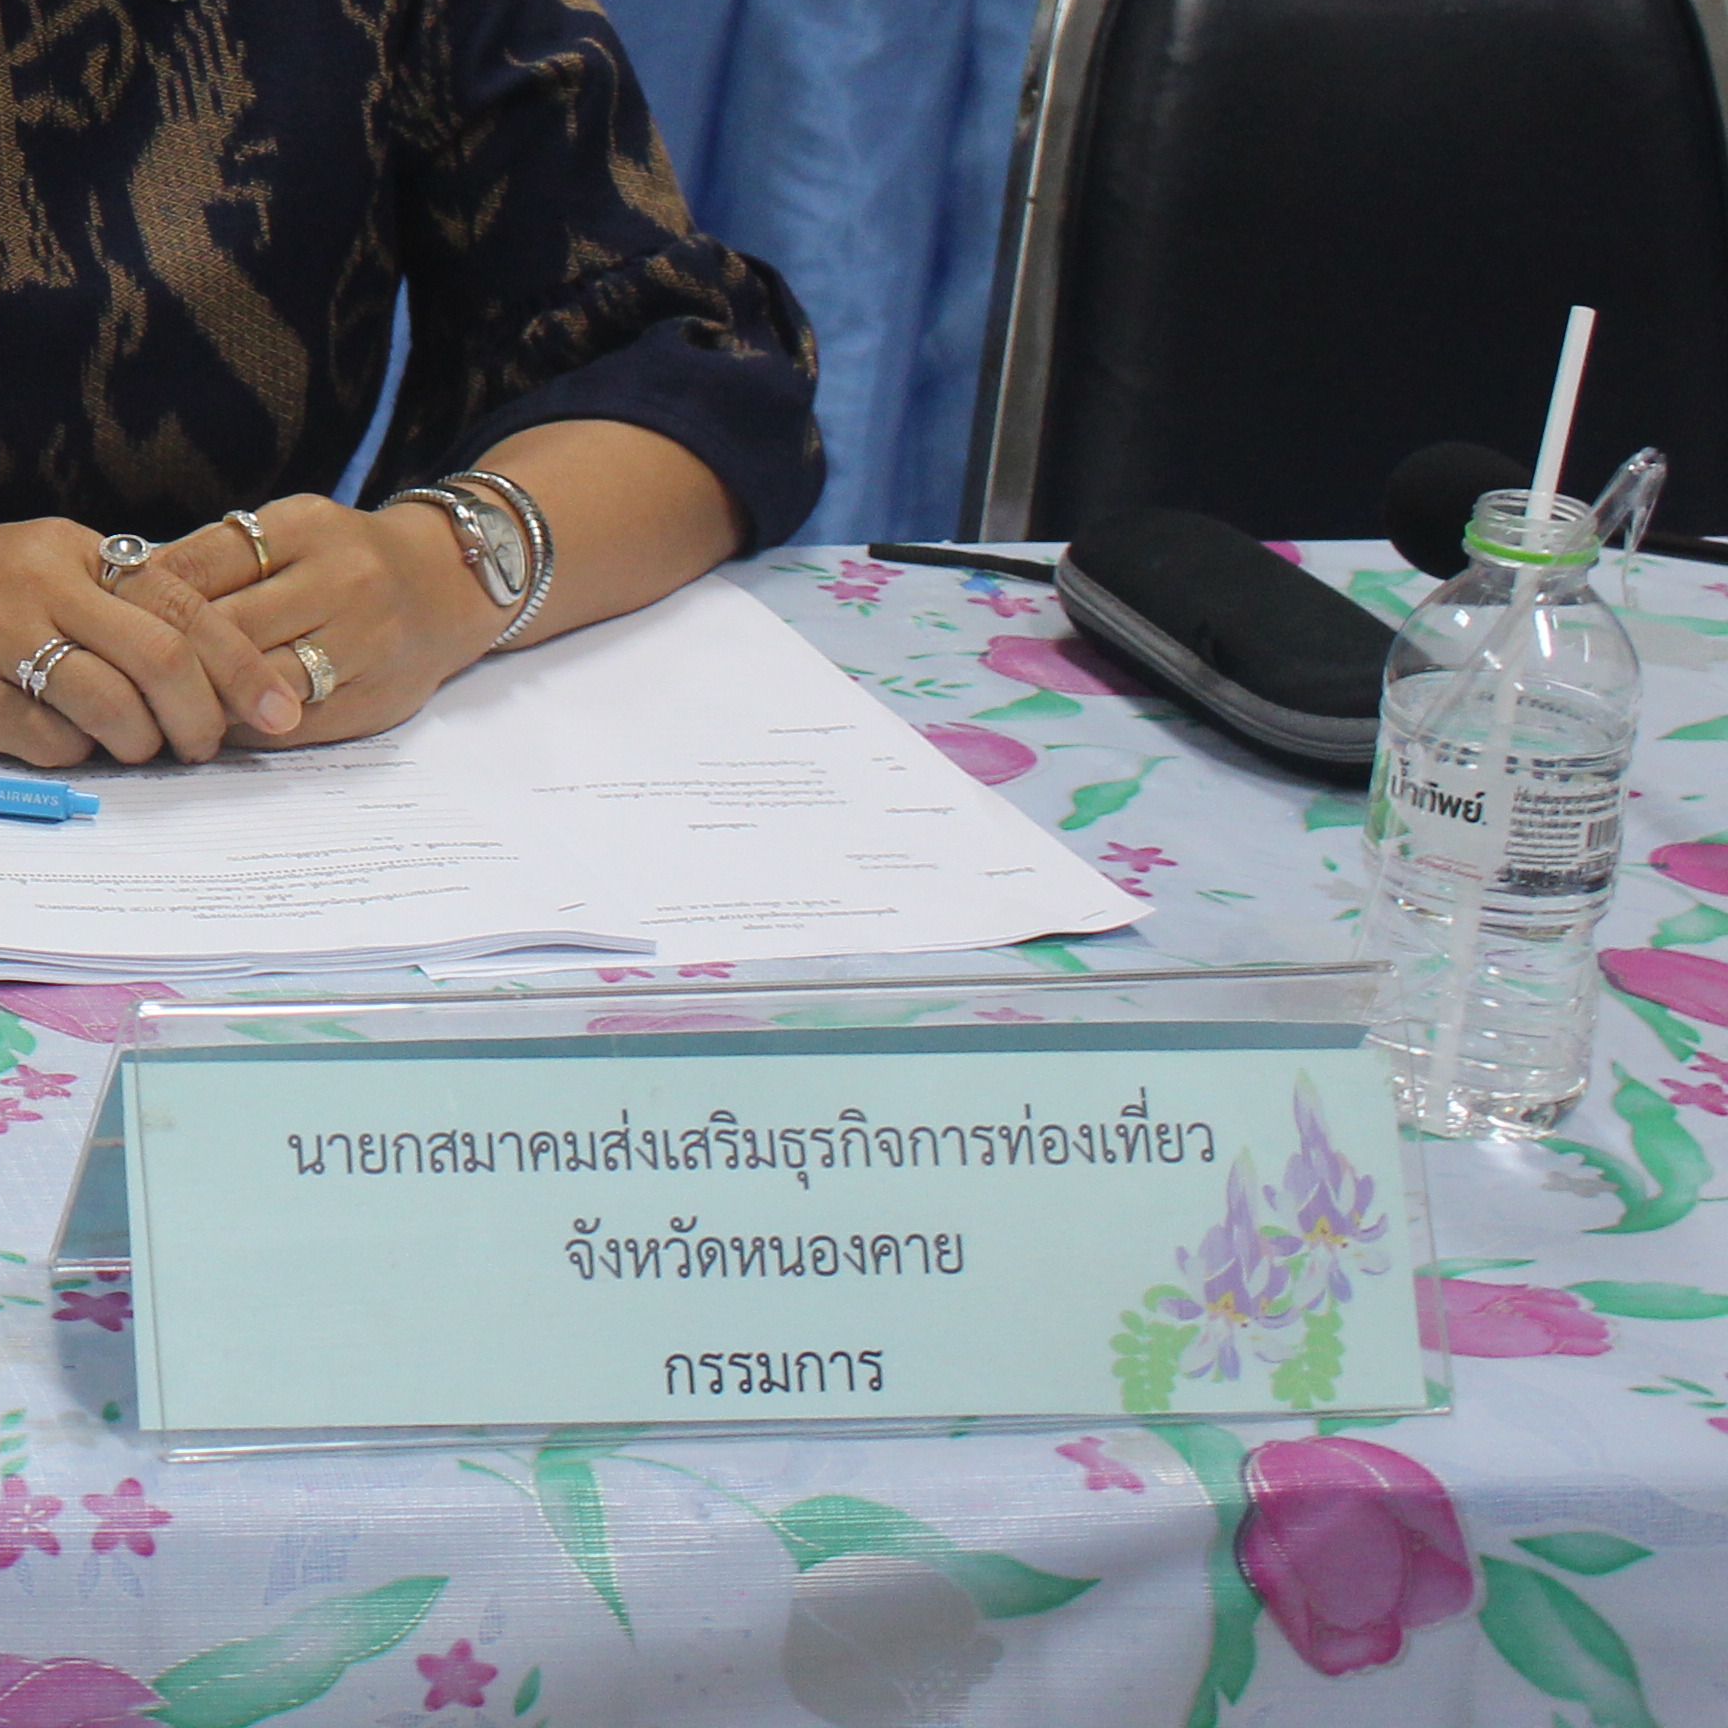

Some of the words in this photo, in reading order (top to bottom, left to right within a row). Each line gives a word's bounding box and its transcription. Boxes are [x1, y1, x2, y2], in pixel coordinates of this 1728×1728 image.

[286, 1085, 1216, 1191] นายกสมาคมส่งเสริมธุรกิจการท่องเที่ยว
[563, 1214, 965, 1282] จังหวัดหนองคาย
[663, 1348, 885, 1397] กรรมการ
